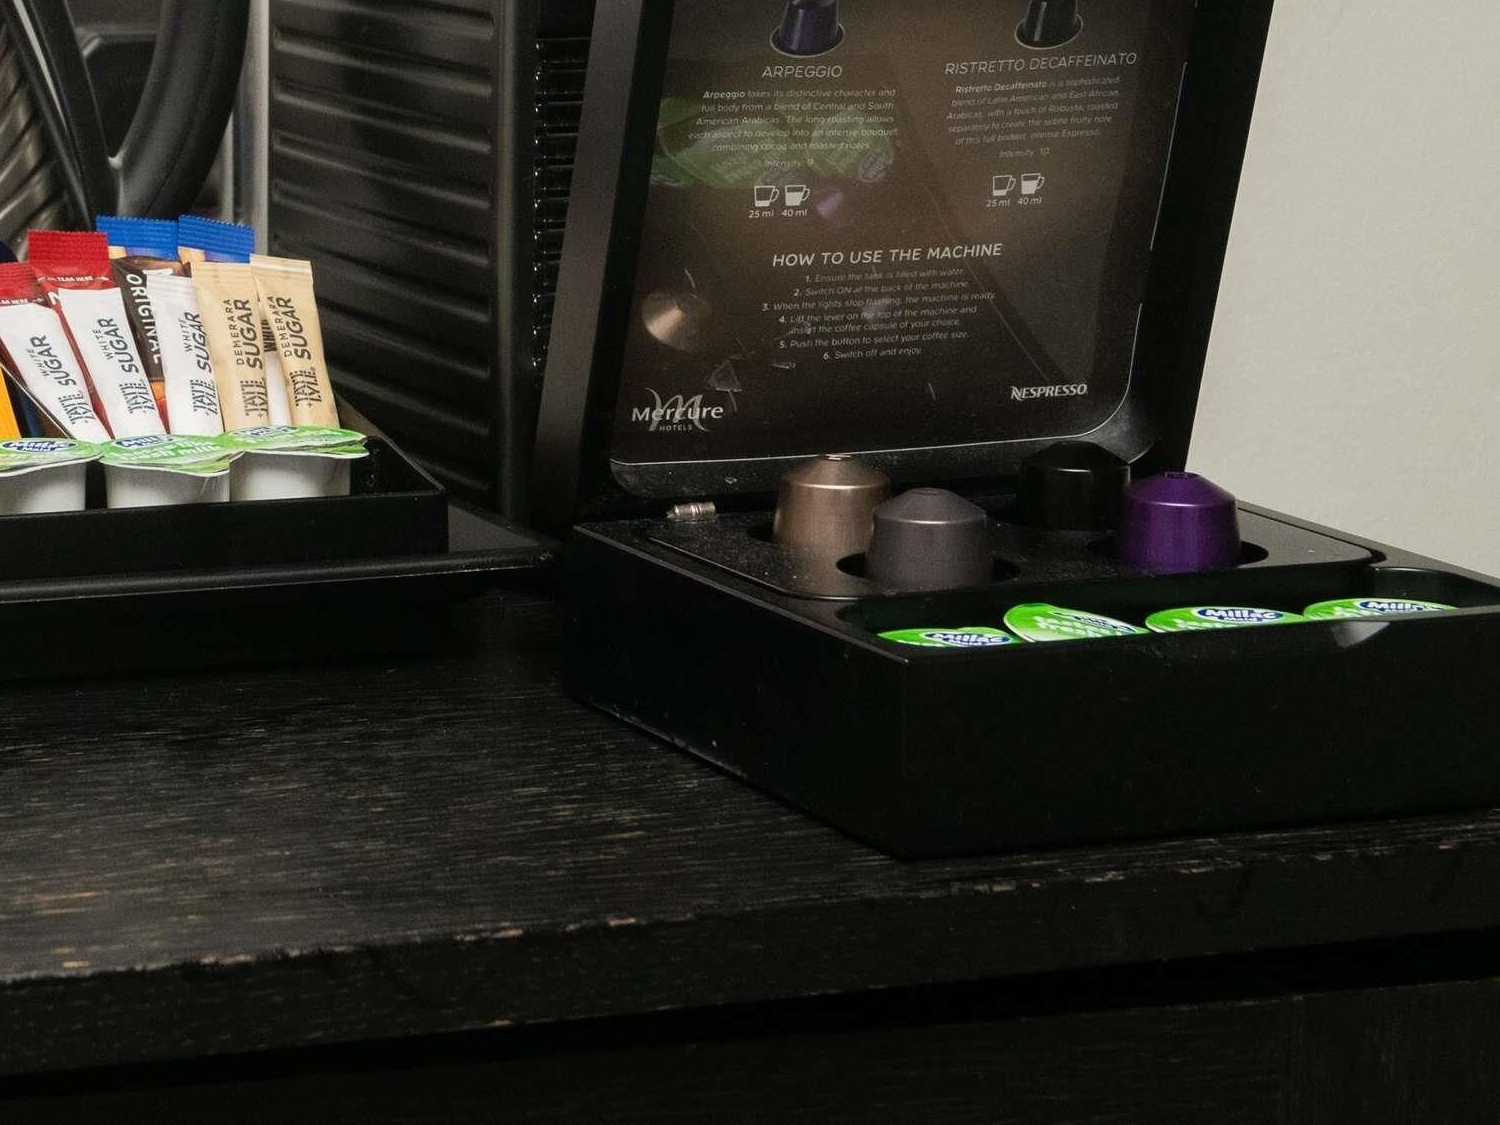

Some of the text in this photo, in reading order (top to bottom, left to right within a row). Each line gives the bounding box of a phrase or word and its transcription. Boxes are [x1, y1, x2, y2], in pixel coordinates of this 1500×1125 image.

[761, 65, 844, 78] ARPEGGIO
[945, 52, 1137, 75] RISTRETTO DECAFFEINATO
[748, 210, 761, 219] 25
[781, 209, 794, 218] 40
[772, 242, 1003, 267] HOW TO USE THE MACHINE
[126, 273, 161, 365] ORIGINAL
[178, 318, 193, 352] WHITE
[223, 299, 245, 365] DEMERARA
[233, 299, 263, 370] SUGAR
[267, 296, 294, 357] DEMERARA
[276, 297, 312, 360] SUGAR
[92, 329, 114, 360] WHITE
[97, 318, 140, 373] SUGAR
[184, 312, 212, 373] SUGAR
[30, 335, 77, 386] SUGAR
[1011, 384, 1088, 401] NESPRESSO
[631, 405, 724, 423] Mercure
[659, 423, 693, 432] HOTELS
[1205, 609, 1278, 621] Millac
